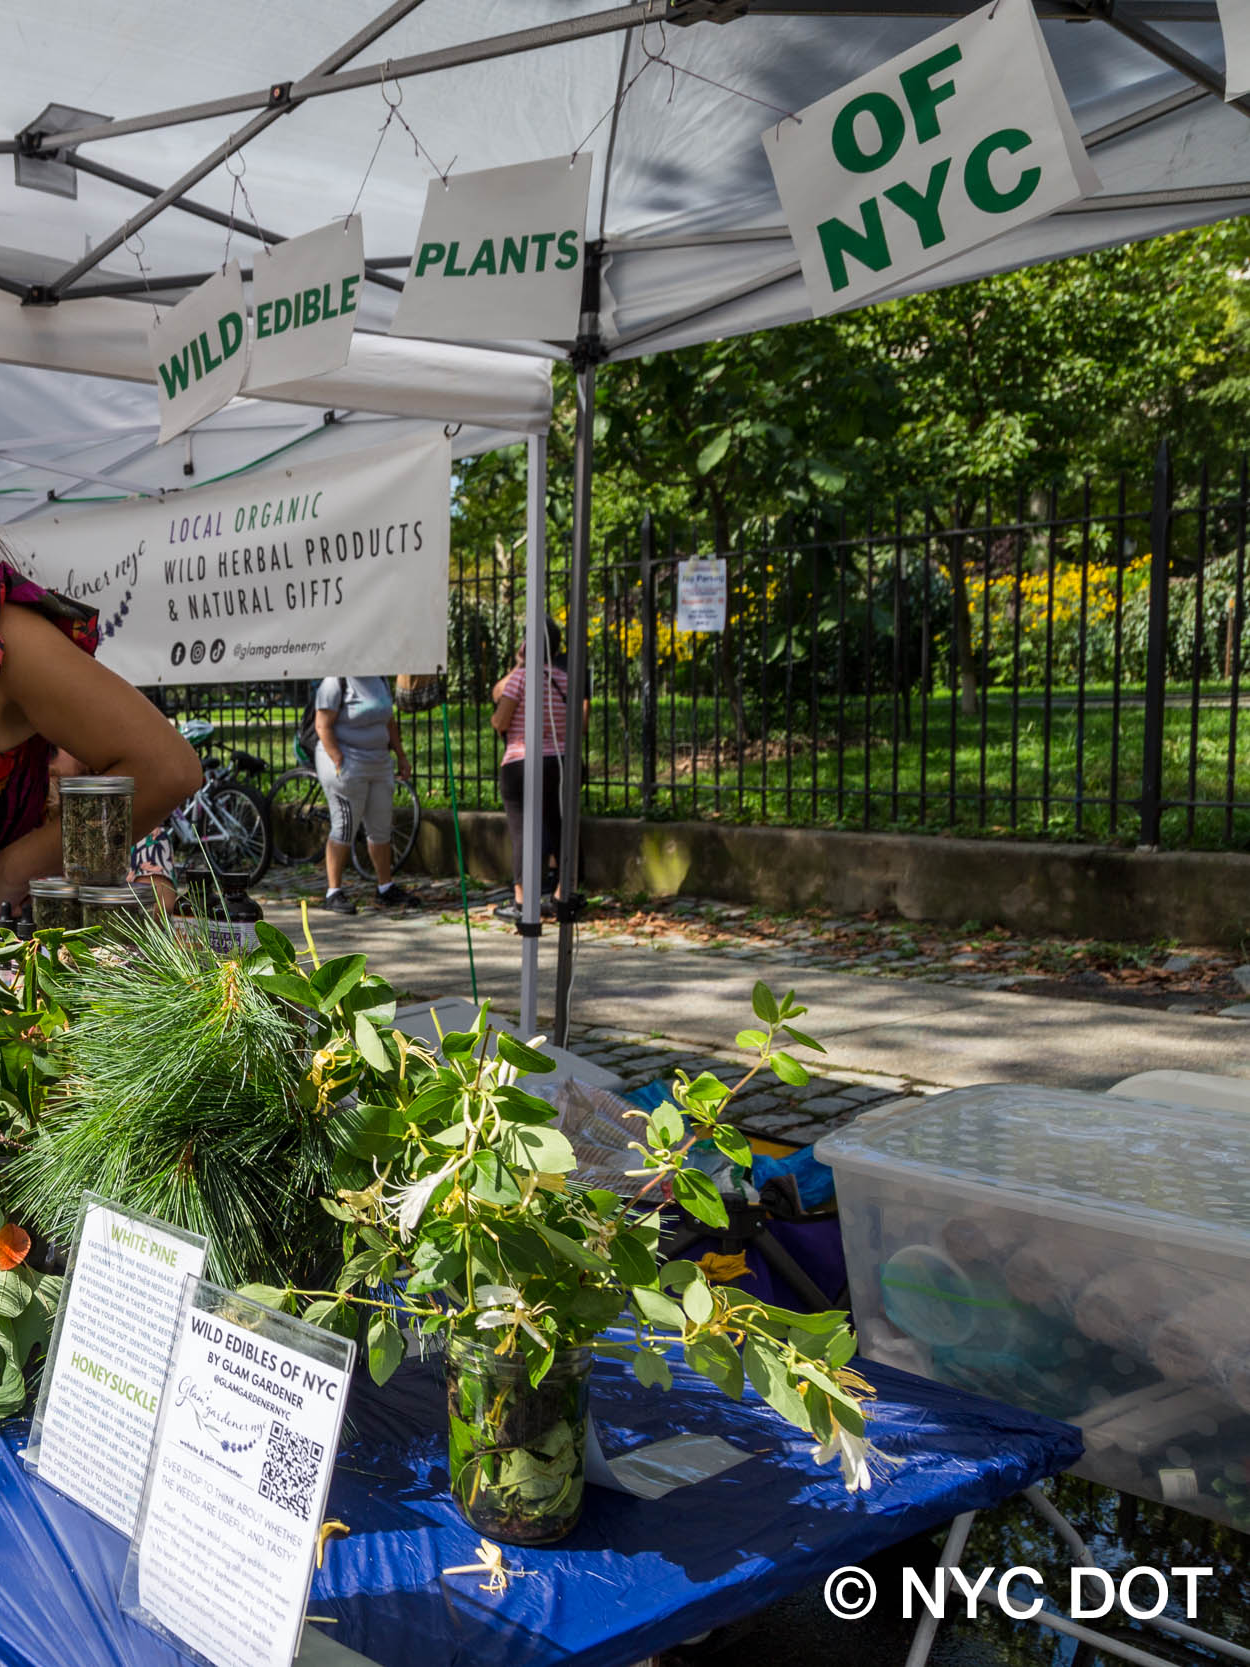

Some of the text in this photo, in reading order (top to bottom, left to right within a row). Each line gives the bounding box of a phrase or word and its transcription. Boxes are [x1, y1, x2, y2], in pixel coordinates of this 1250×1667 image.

[832, 43, 962, 174] OF
[816, 128, 1042, 293] NYC
[415, 230, 579, 278] PLANTS
[257, 275, 361, 340] EDIBLE
[158, 311, 244, 400] WILD
[169, 491, 323, 544] LOCAL ORGANIC
[164, 520, 423, 584] WILD HERBAL PRODUCTS
[168, 577, 343, 621] & NATURAL GIFTS
[233, 640, 327, 660] @glamgardenernyc
[112, 1224, 178, 1267] WHITE PINE
[117, 1279, 129, 1290] YEAR
[148, 1294, 163, 1307] SINCE
[151, 1282, 174, 1298] NEEDLES
[72, 1352, 157, 1412] HONEYSUCKLE
[192, 1316, 338, 1401] WILD EDIBLES OF NYC
[207, 1351, 303, 1409] BY GLAM GARDENER
[175, 1376, 204, 1407] Glam
[214, 1375, 290, 1421] @GLAMGARDENERNYC
[180, 1440, 198, 1454] website
[216, 1460, 243, 1479] newsletter
[162, 1474, 296, 1561] THE WEEDS ARE USEFUL AND TASTY?
[163, 1456, 302, 1547] EVER STOP TO THINK ABOUT WHETHER
